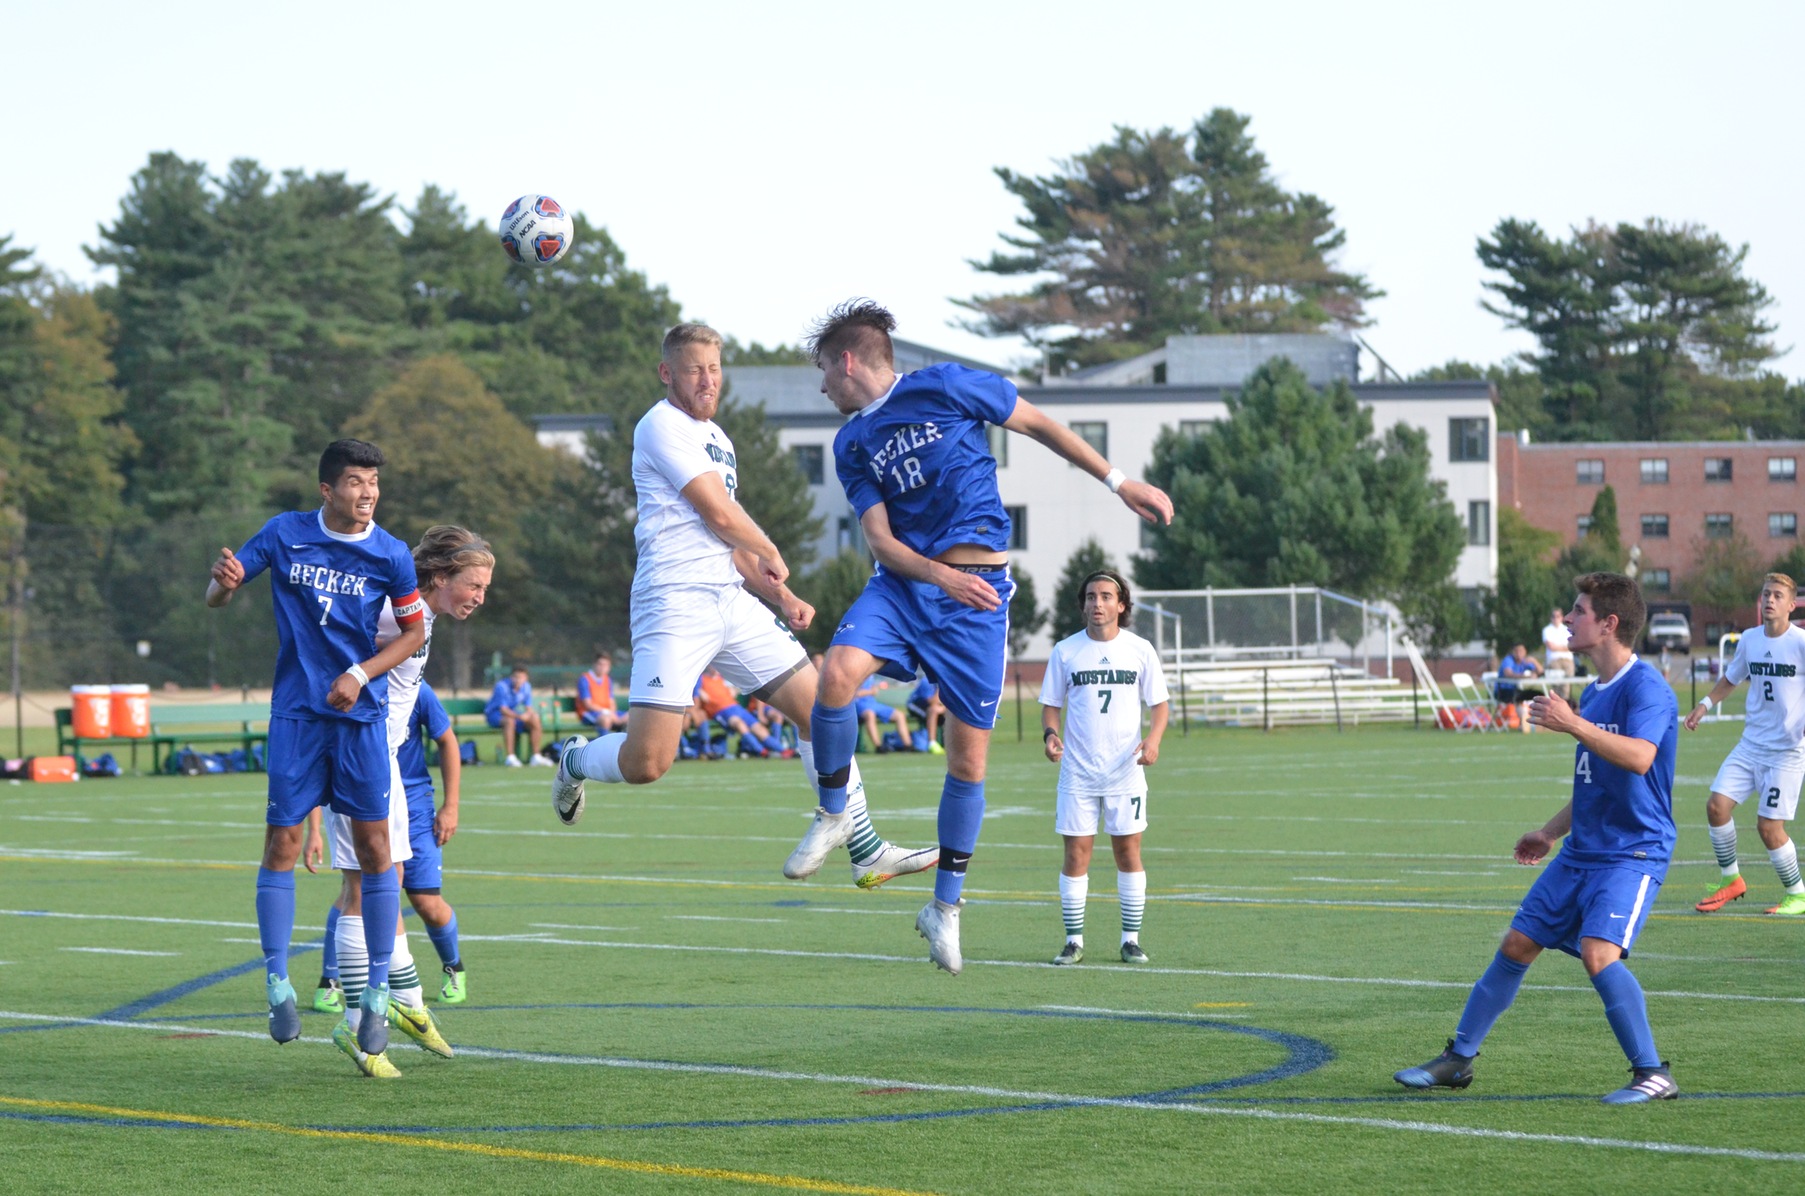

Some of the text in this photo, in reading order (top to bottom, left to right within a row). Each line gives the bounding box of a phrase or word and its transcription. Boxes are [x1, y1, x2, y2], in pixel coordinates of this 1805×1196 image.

[509, 211, 530, 231] Wilson
[519, 220, 537, 239] NCAA
[891, 456, 927, 494] 18
[289, 563, 368, 597] BECKER
[317, 594, 333, 626] 7
[1071, 669, 1137, 687] MUSTANGS
[1098, 690, 1112, 714] 7
[1763, 680, 1775, 702] 2
[1576, 751, 1592, 784] 4
[1131, 796, 1141, 820] 7
[1766, 786, 1781, 808] 2
